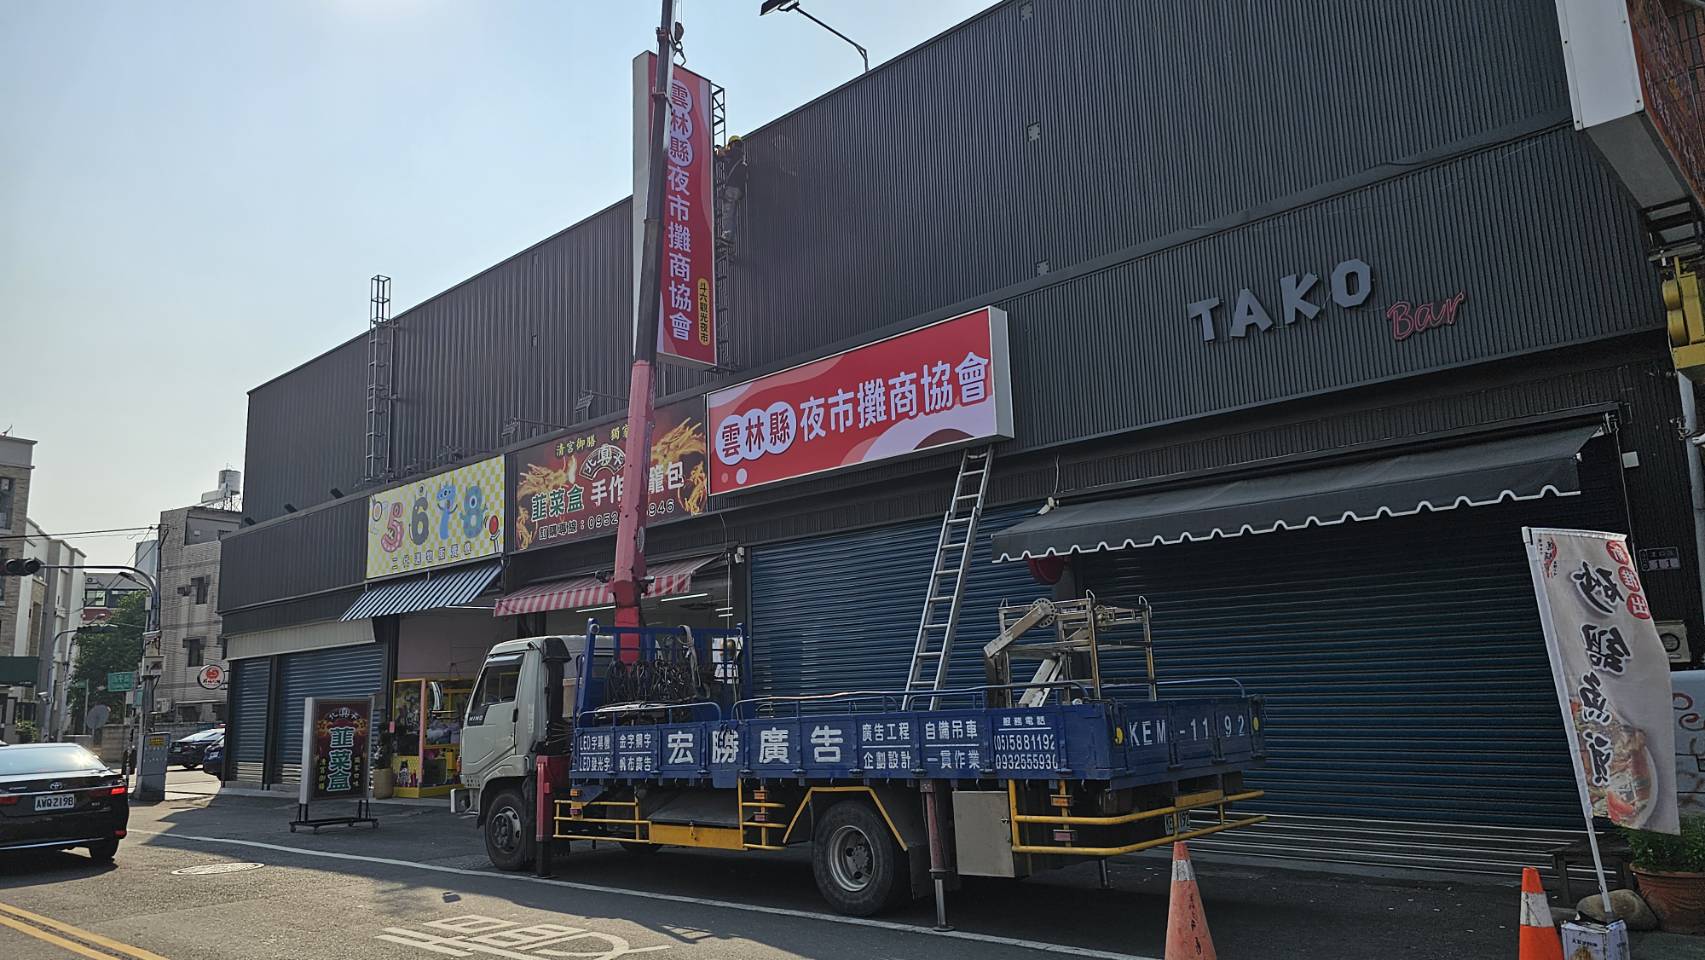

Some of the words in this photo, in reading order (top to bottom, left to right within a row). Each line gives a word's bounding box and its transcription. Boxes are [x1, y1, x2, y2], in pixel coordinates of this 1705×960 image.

[667, 82, 693, 341] 雲林縣夜市攤商協會
[1187, 258, 1371, 342] TAKO
[1386, 290, 1465, 340] Bar
[721, 351, 989, 457] 雲林縣夜市攤商協會
[531, 484, 585, 522] 韭菜盒
[590, 461, 684, 507] 手作籠包
[381, 484, 484, 552] 5678
[862, 722, 910, 742] 廣告工程
[925, 719, 978, 740] 自備吊車
[1002, 715, 1046, 726] 服務電話
[327, 726, 356, 791] 韭菜盒
[667, 726, 844, 764] 宏勝廣告
[927, 749, 980, 769] 一貫作業
[579, 757, 611, 771] LED發光字
[619, 756, 652, 771] 帆布廣告
[863, 750, 911, 770] 企劃設計
